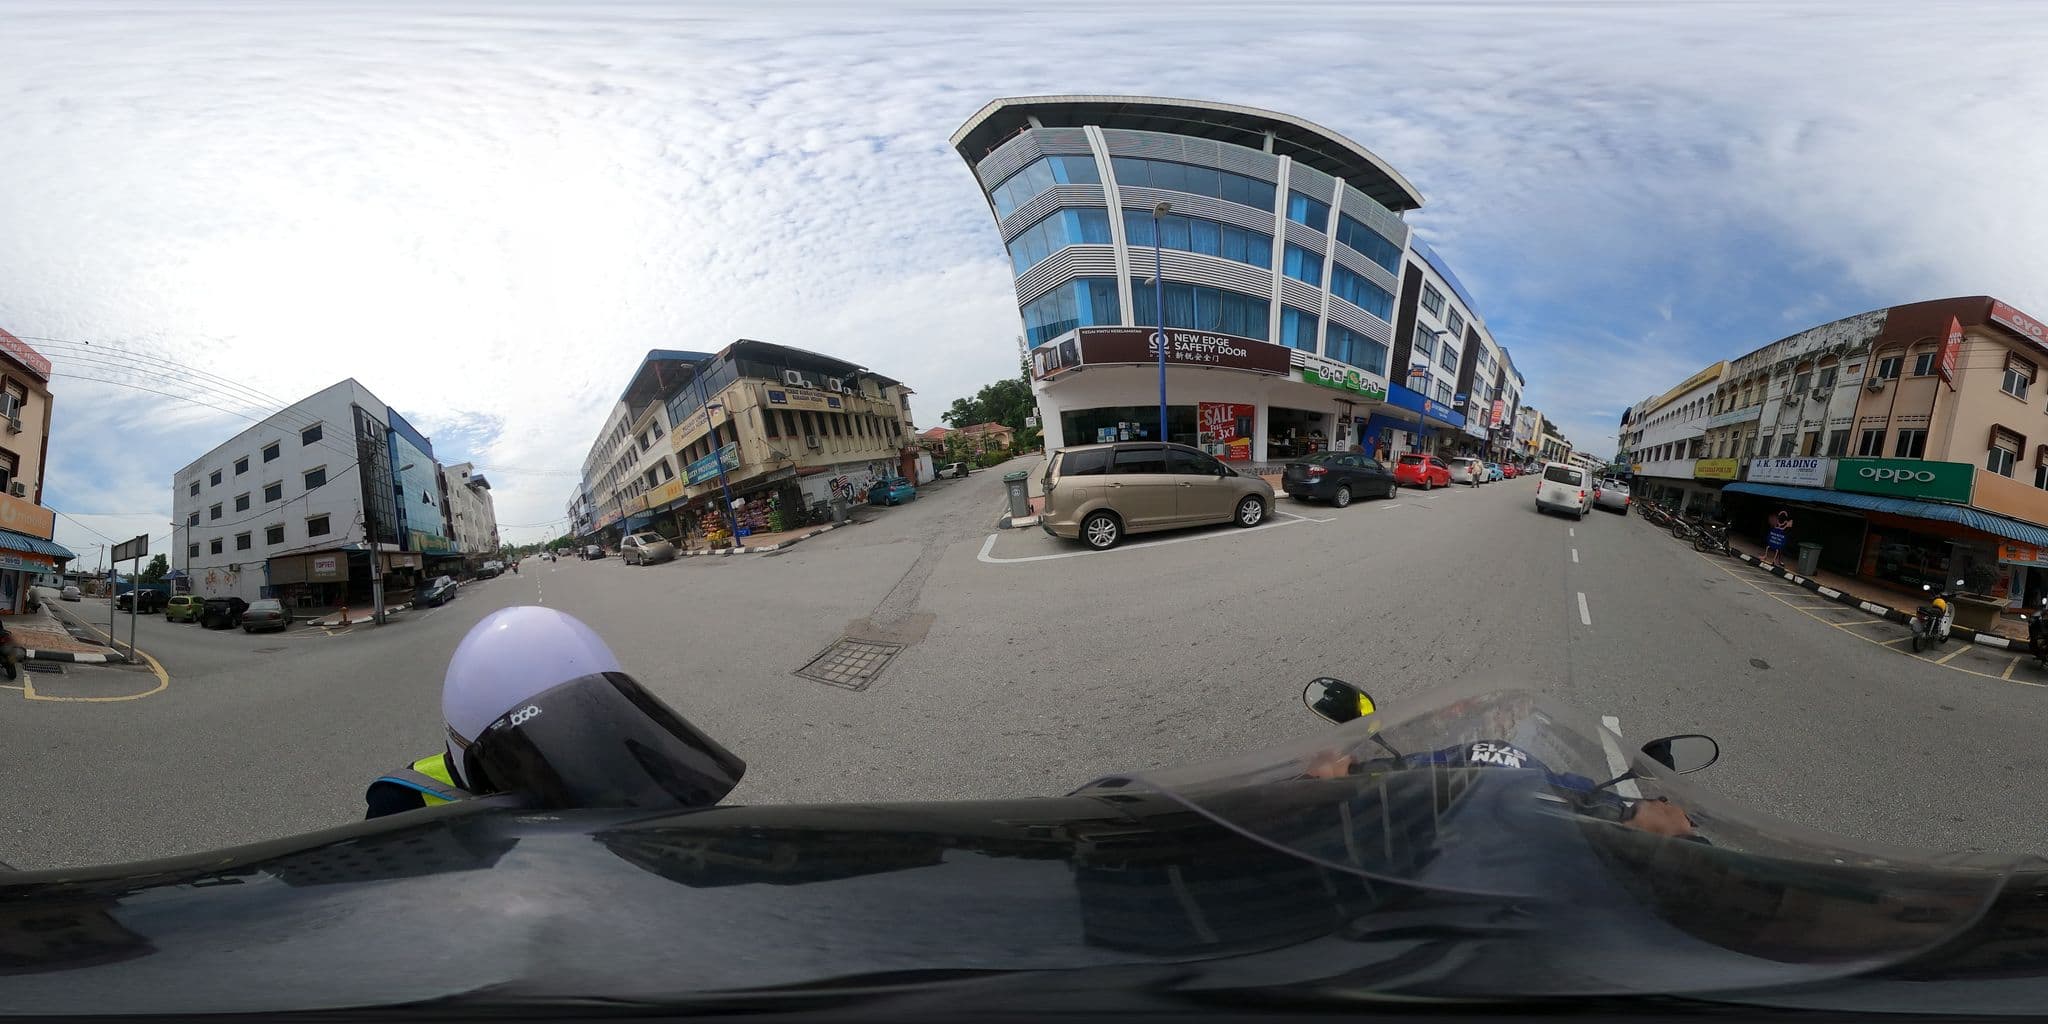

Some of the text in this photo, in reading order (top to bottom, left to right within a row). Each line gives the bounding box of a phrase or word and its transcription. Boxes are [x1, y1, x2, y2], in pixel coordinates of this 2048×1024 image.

[2012, 315, 2042, 336] OYO
[1174, 333, 1230, 347] NEW EDGE
[1174, 342, 1215, 354] SAFETY
[1218, 346, 1248, 357] DOOR
[1204, 405, 1234, 426] SALE
[1775, 459, 1818, 468] TRADING
[1470, 751, 1520, 768] WYM
